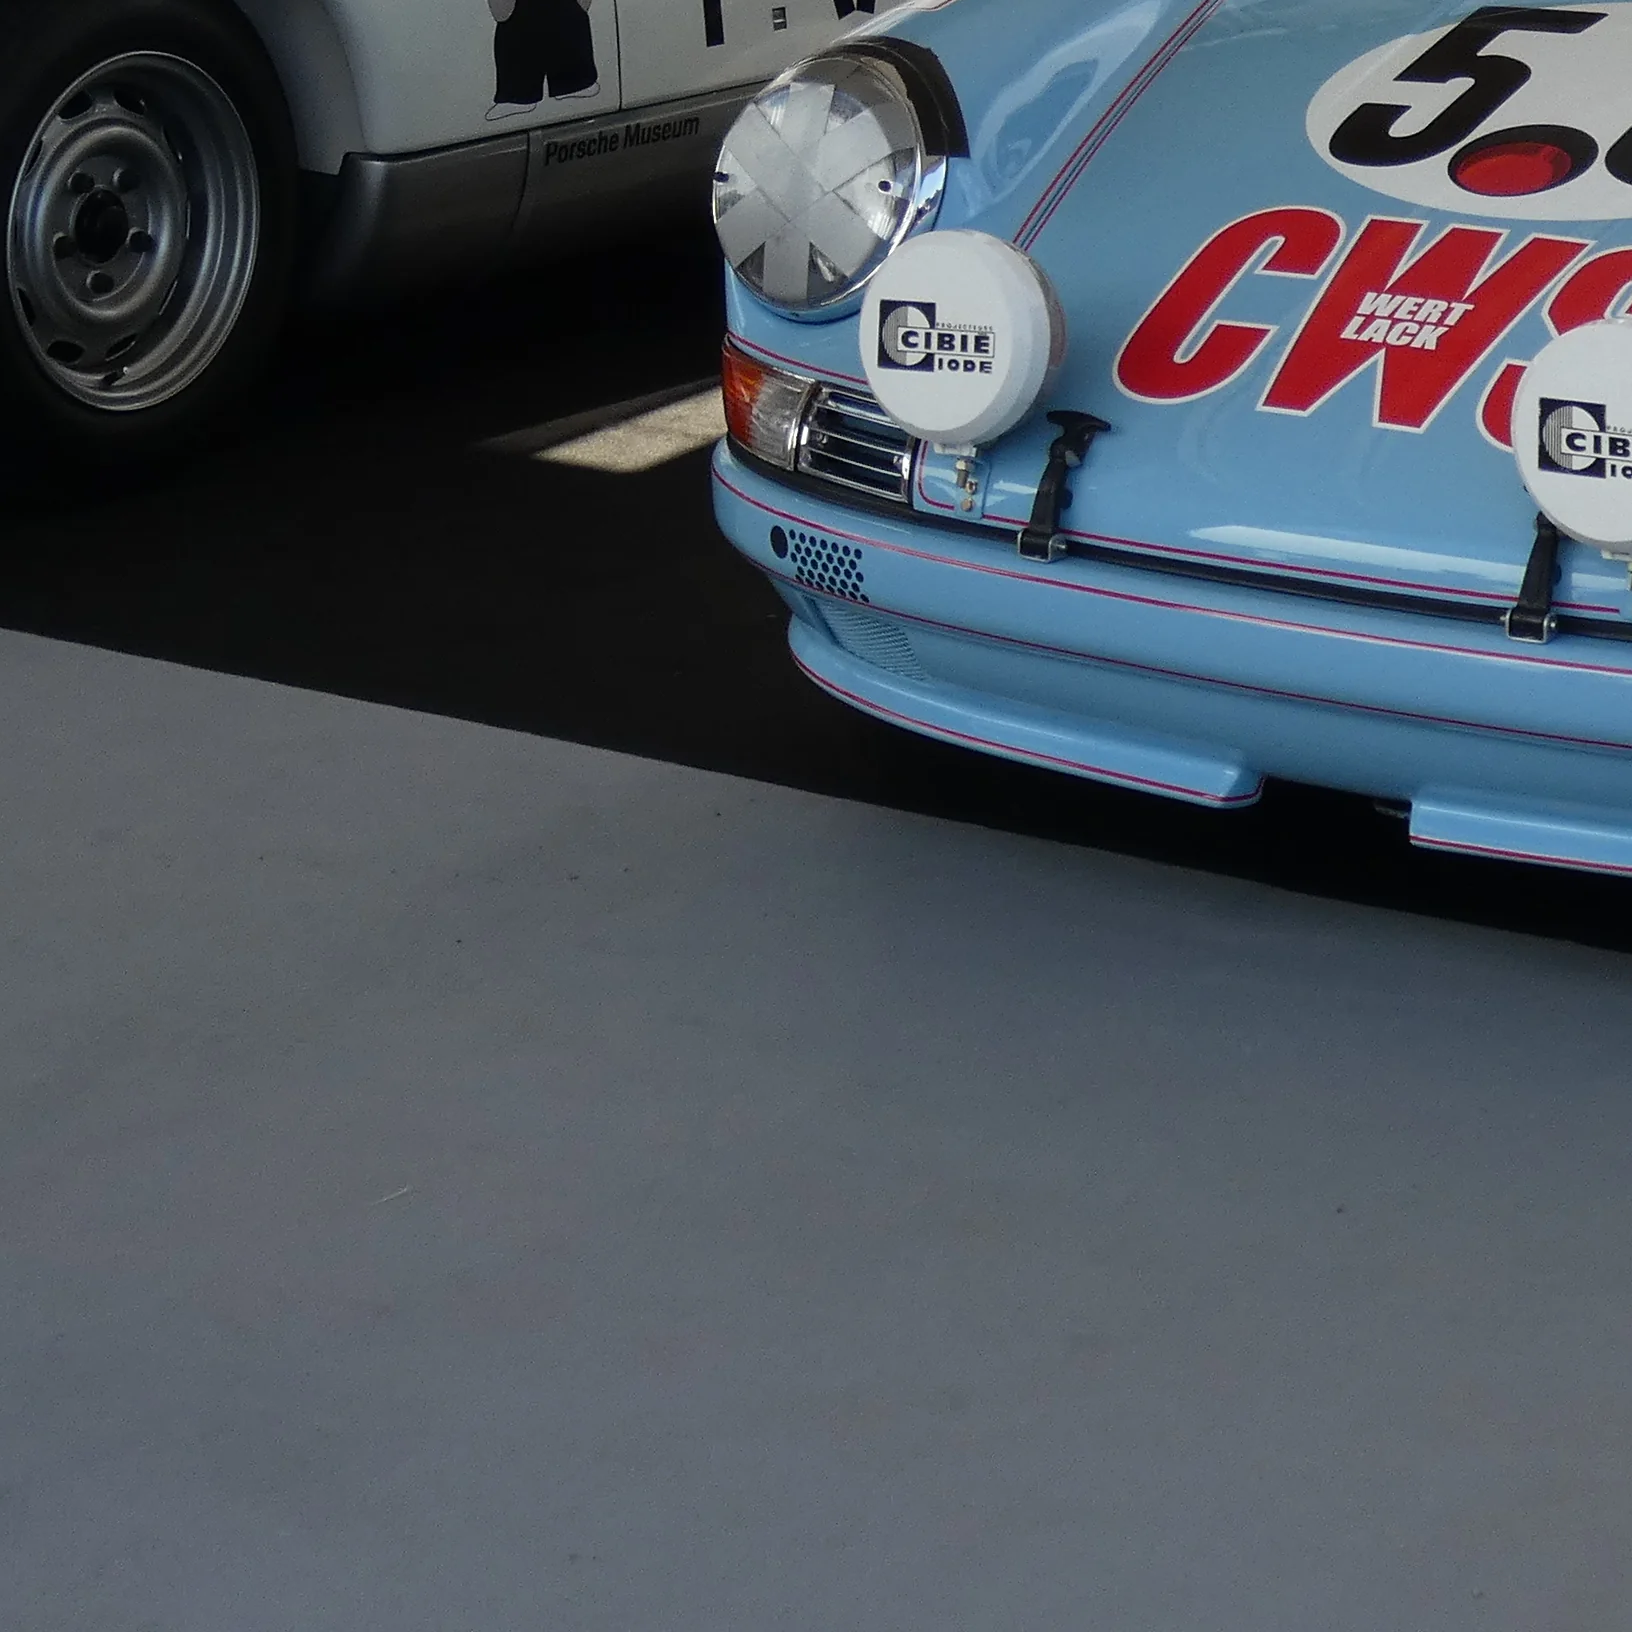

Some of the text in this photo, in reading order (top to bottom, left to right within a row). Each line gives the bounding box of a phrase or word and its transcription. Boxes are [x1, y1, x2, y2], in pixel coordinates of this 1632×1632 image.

[543, 116, 700, 167] Porsche Museum
[1358, 291, 1476, 326] WERT
[1340, 316, 1451, 352] LACK
[937, 357, 993, 374] IODE
